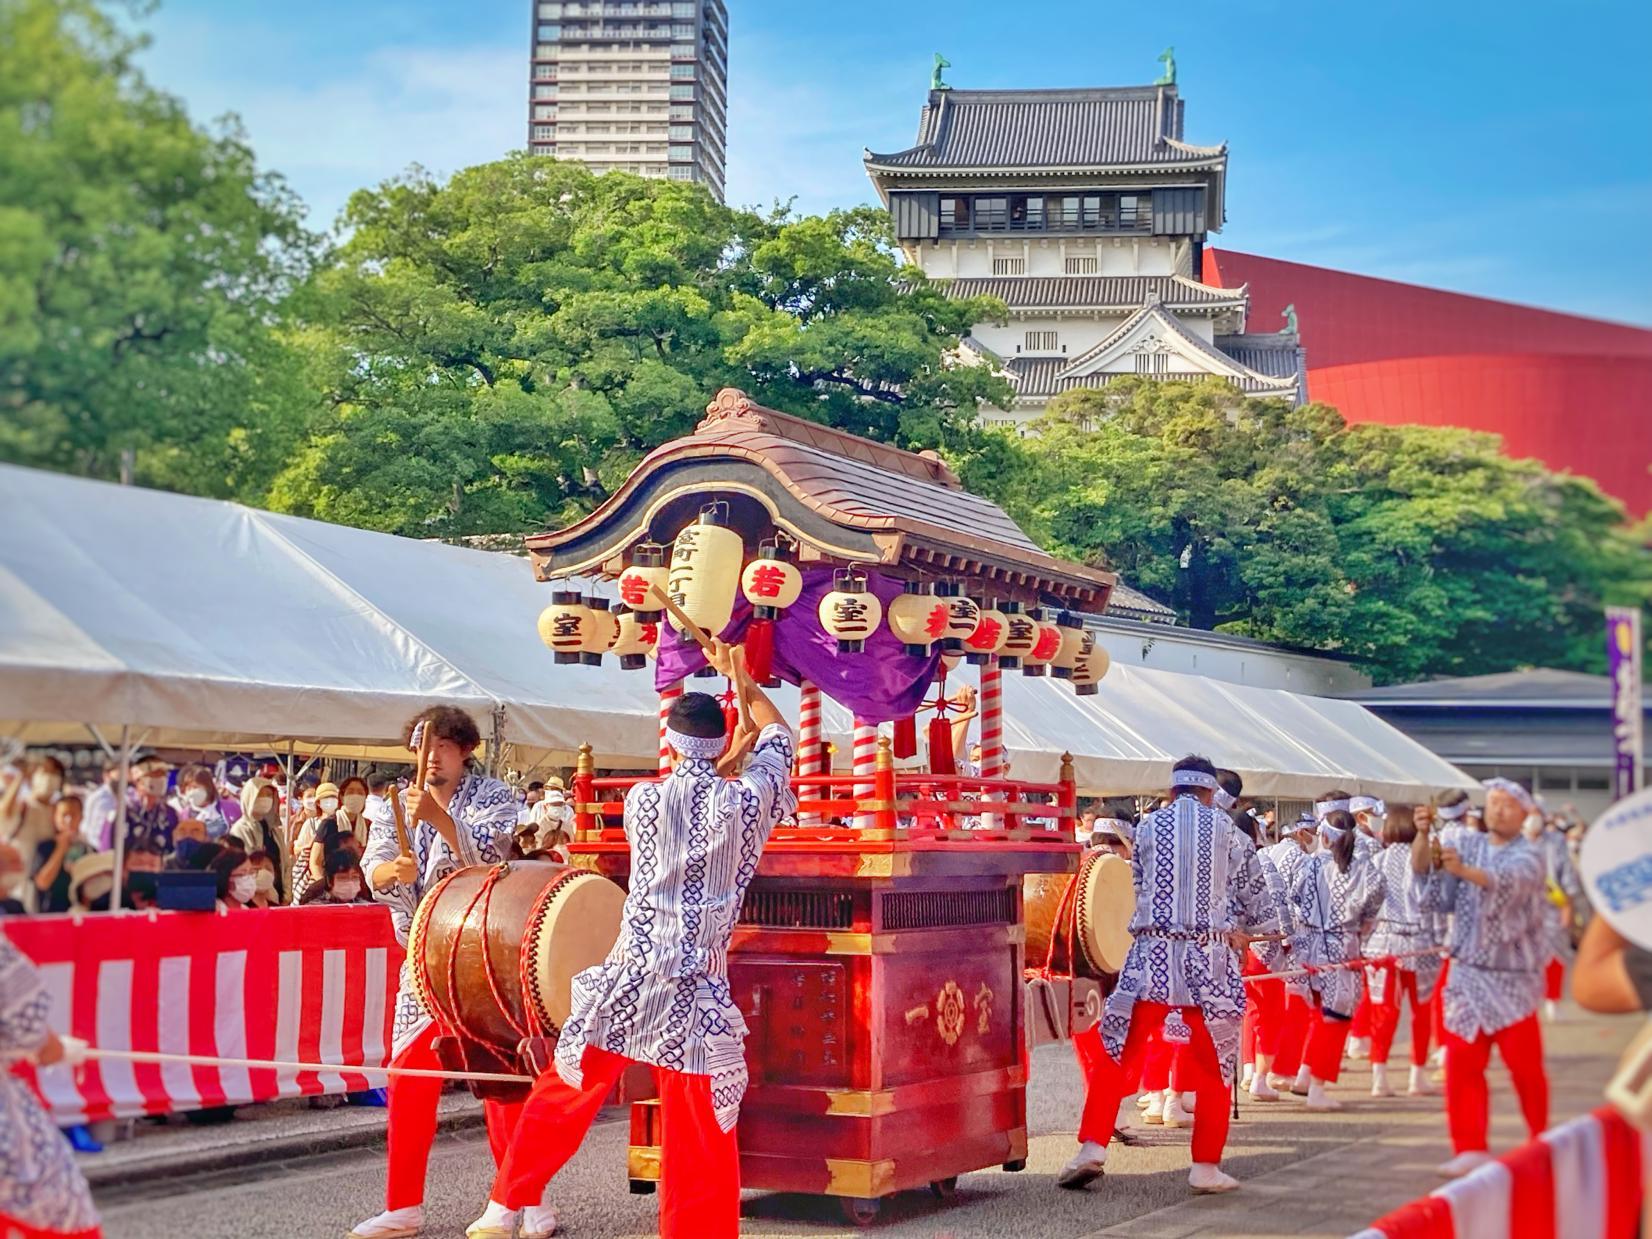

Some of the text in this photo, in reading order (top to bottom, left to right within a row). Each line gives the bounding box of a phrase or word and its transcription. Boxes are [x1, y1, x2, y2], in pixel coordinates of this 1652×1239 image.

[621, 574, 650, 605] 若
[749, 565, 786, 598] 若
[553, 612, 582, 647] 室一
[833, 597, 868, 632] 室一
[949, 599, 978, 632] 室一
[1005, 618, 1034, 649] 室一
